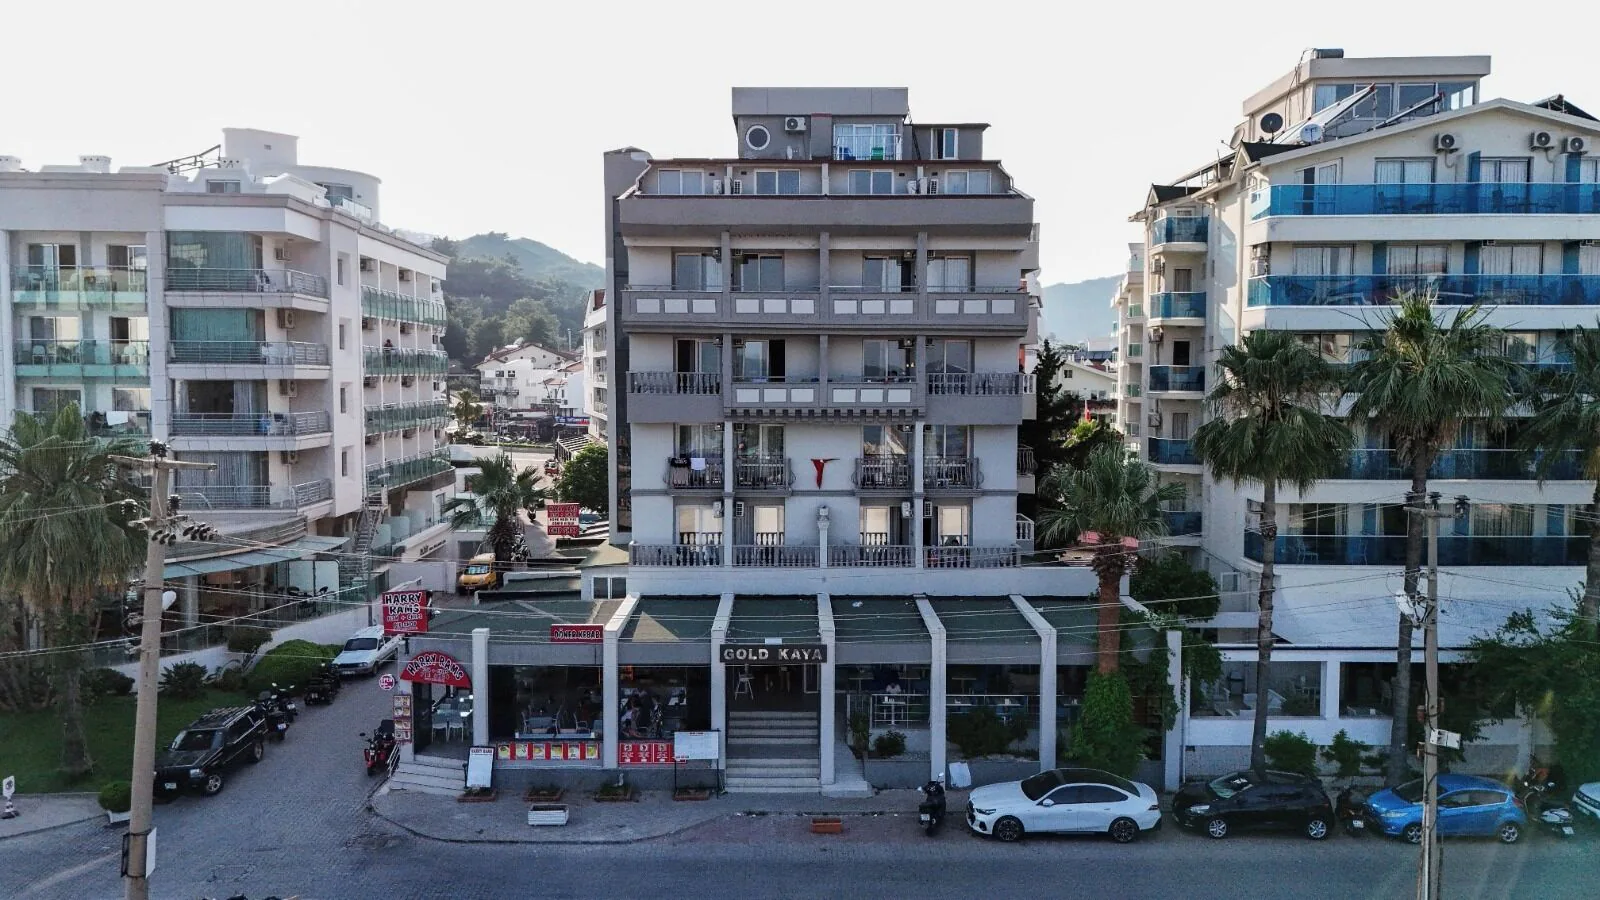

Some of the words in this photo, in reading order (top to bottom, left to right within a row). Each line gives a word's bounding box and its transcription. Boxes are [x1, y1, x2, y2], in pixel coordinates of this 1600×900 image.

[385, 592, 422, 604] HARRY
[389, 603, 420, 615] RAMS
[723, 648, 769, 660] GOLD
[778, 648, 822, 660] KAYA
[407, 653, 437, 675] HARRY
[439, 655, 464, 680] RAMS
